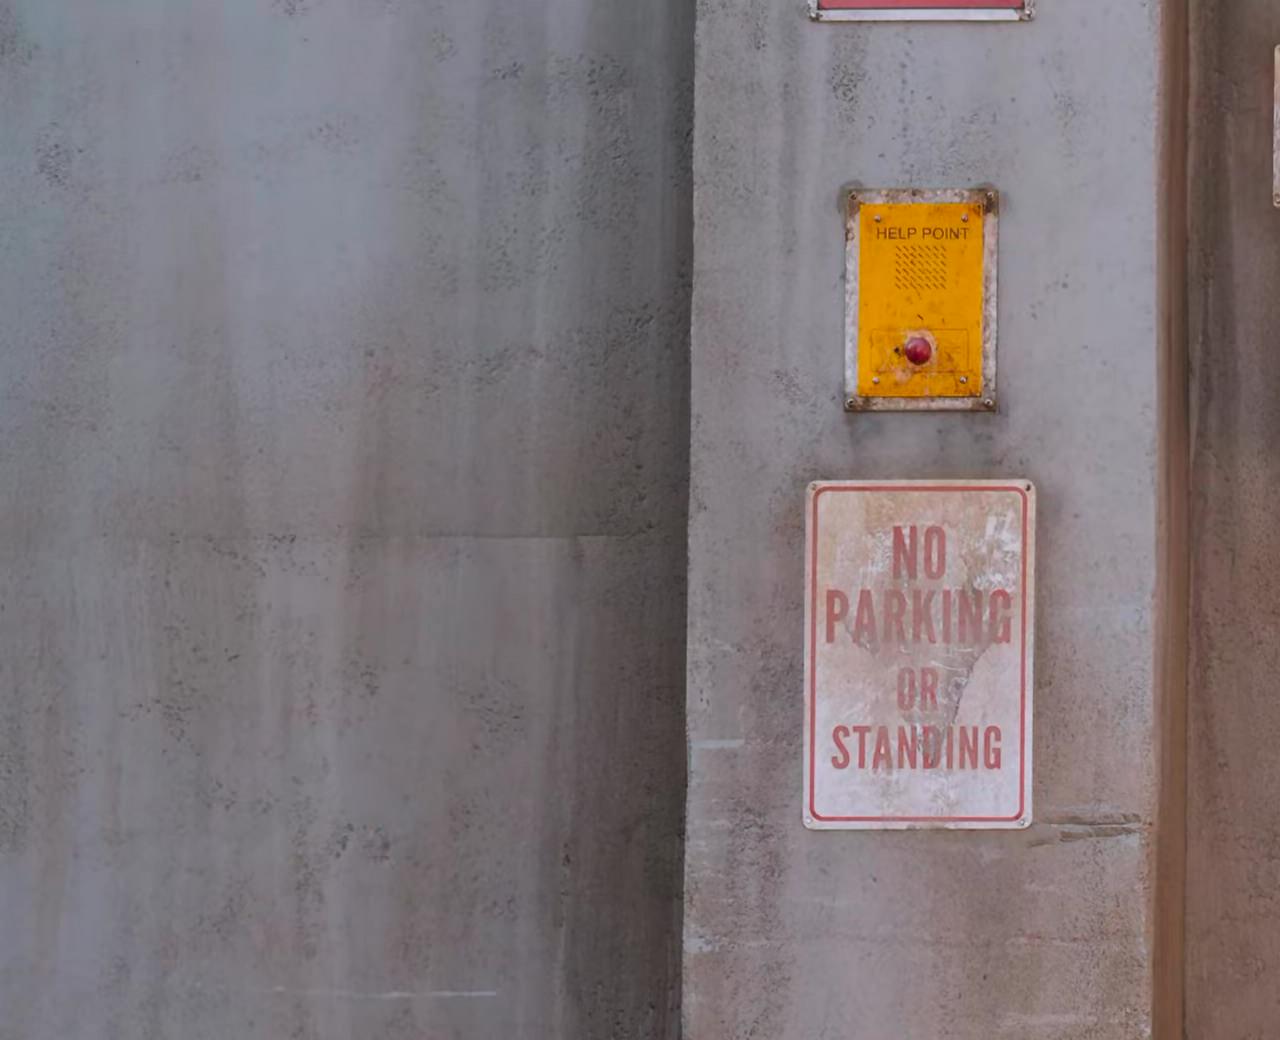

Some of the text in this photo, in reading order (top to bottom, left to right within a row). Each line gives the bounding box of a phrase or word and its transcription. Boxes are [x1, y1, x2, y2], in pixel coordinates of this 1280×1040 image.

[876, 227, 970, 241] HELP POINT
[892, 524, 947, 581] NO
[825, 588, 1014, 645] PARKING
[896, 666, 940, 713] OR
[831, 725, 1002, 770] STANDING
